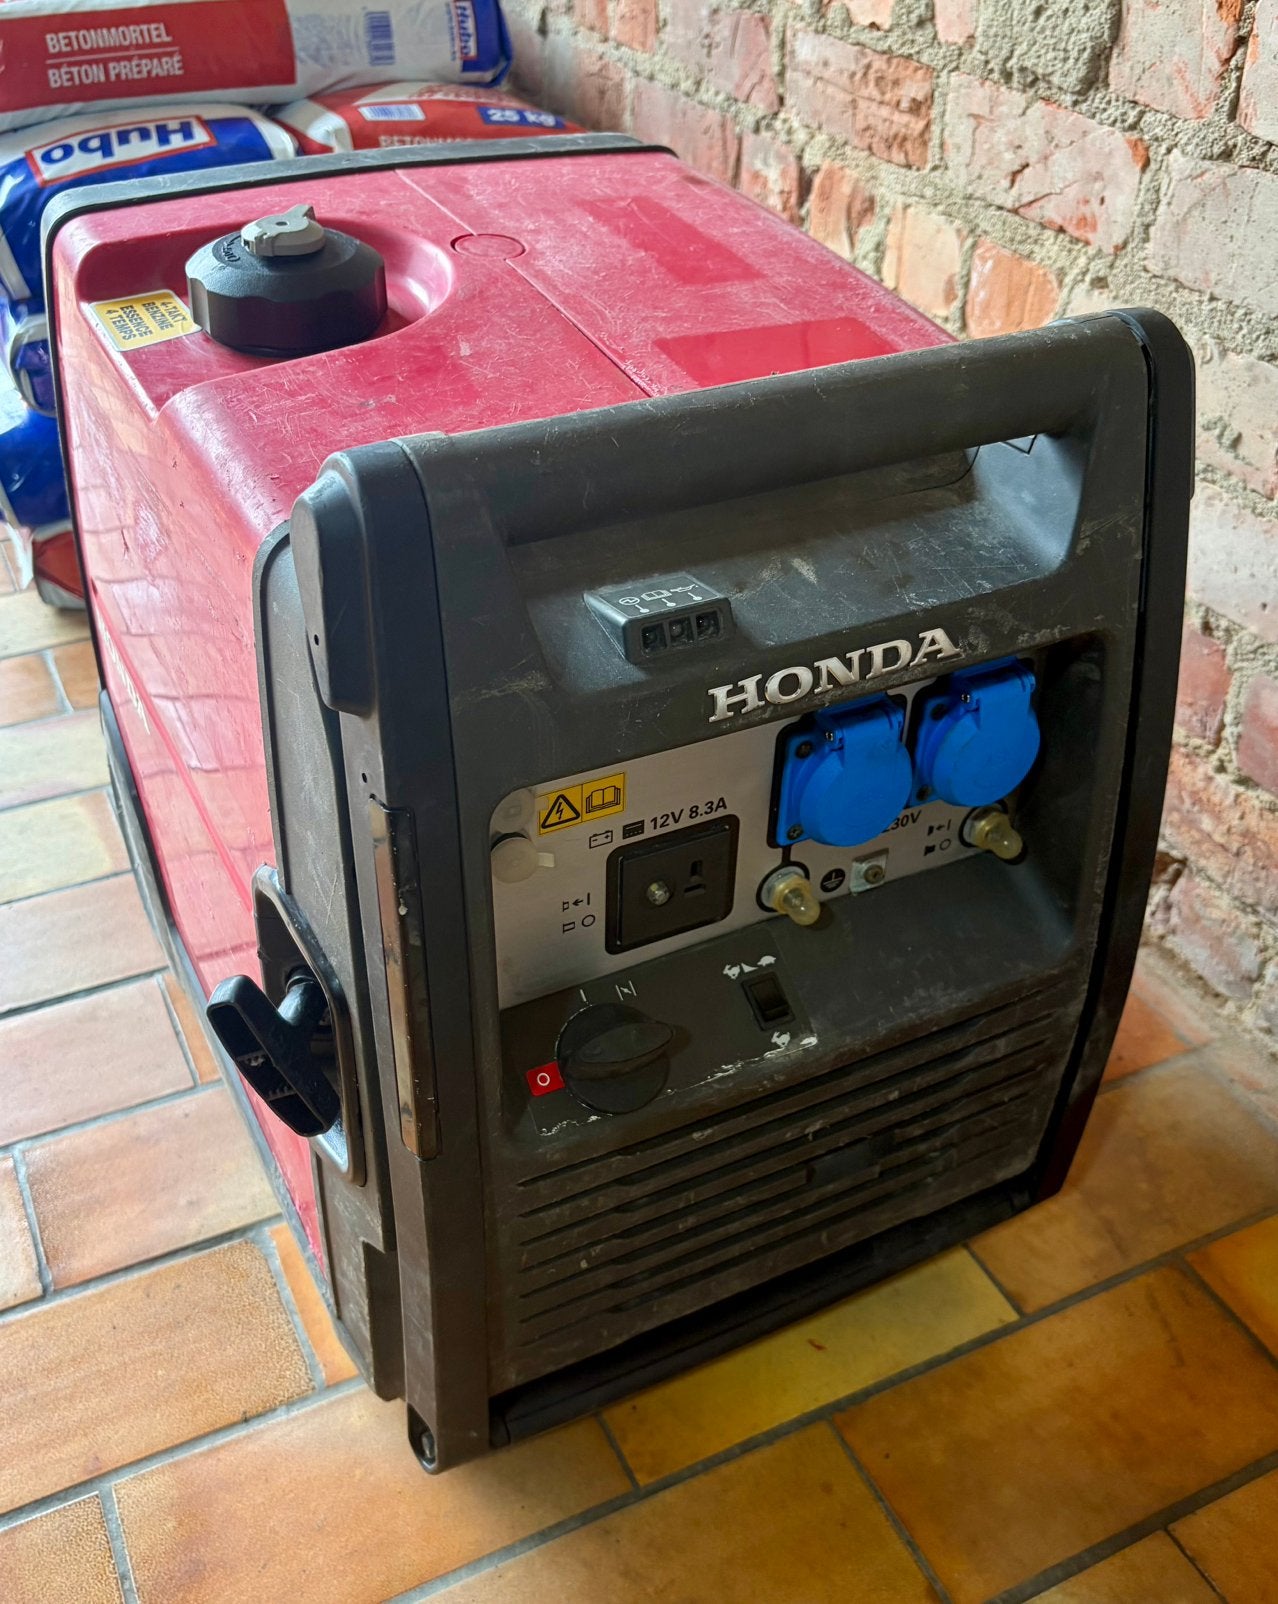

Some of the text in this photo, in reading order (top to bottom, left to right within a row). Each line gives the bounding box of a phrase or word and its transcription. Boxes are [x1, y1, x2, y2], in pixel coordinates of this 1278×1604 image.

[45, 22, 173, 54] BETONMORTEL
[48, 52, 184, 88] BÉTON PRÉPARÉ
[487, 108, 520, 122] 25
[40, 120, 196, 165] Hubo
[109, 314, 137, 341] TEMPS
[120, 304, 154, 338] ESSENCE
[141, 301, 174, 331] BENZINE
[707, 627, 966, 723] HONDA
[650, 796, 728, 831] 12V 8.3A
[881, 809, 922, 834] 30V
